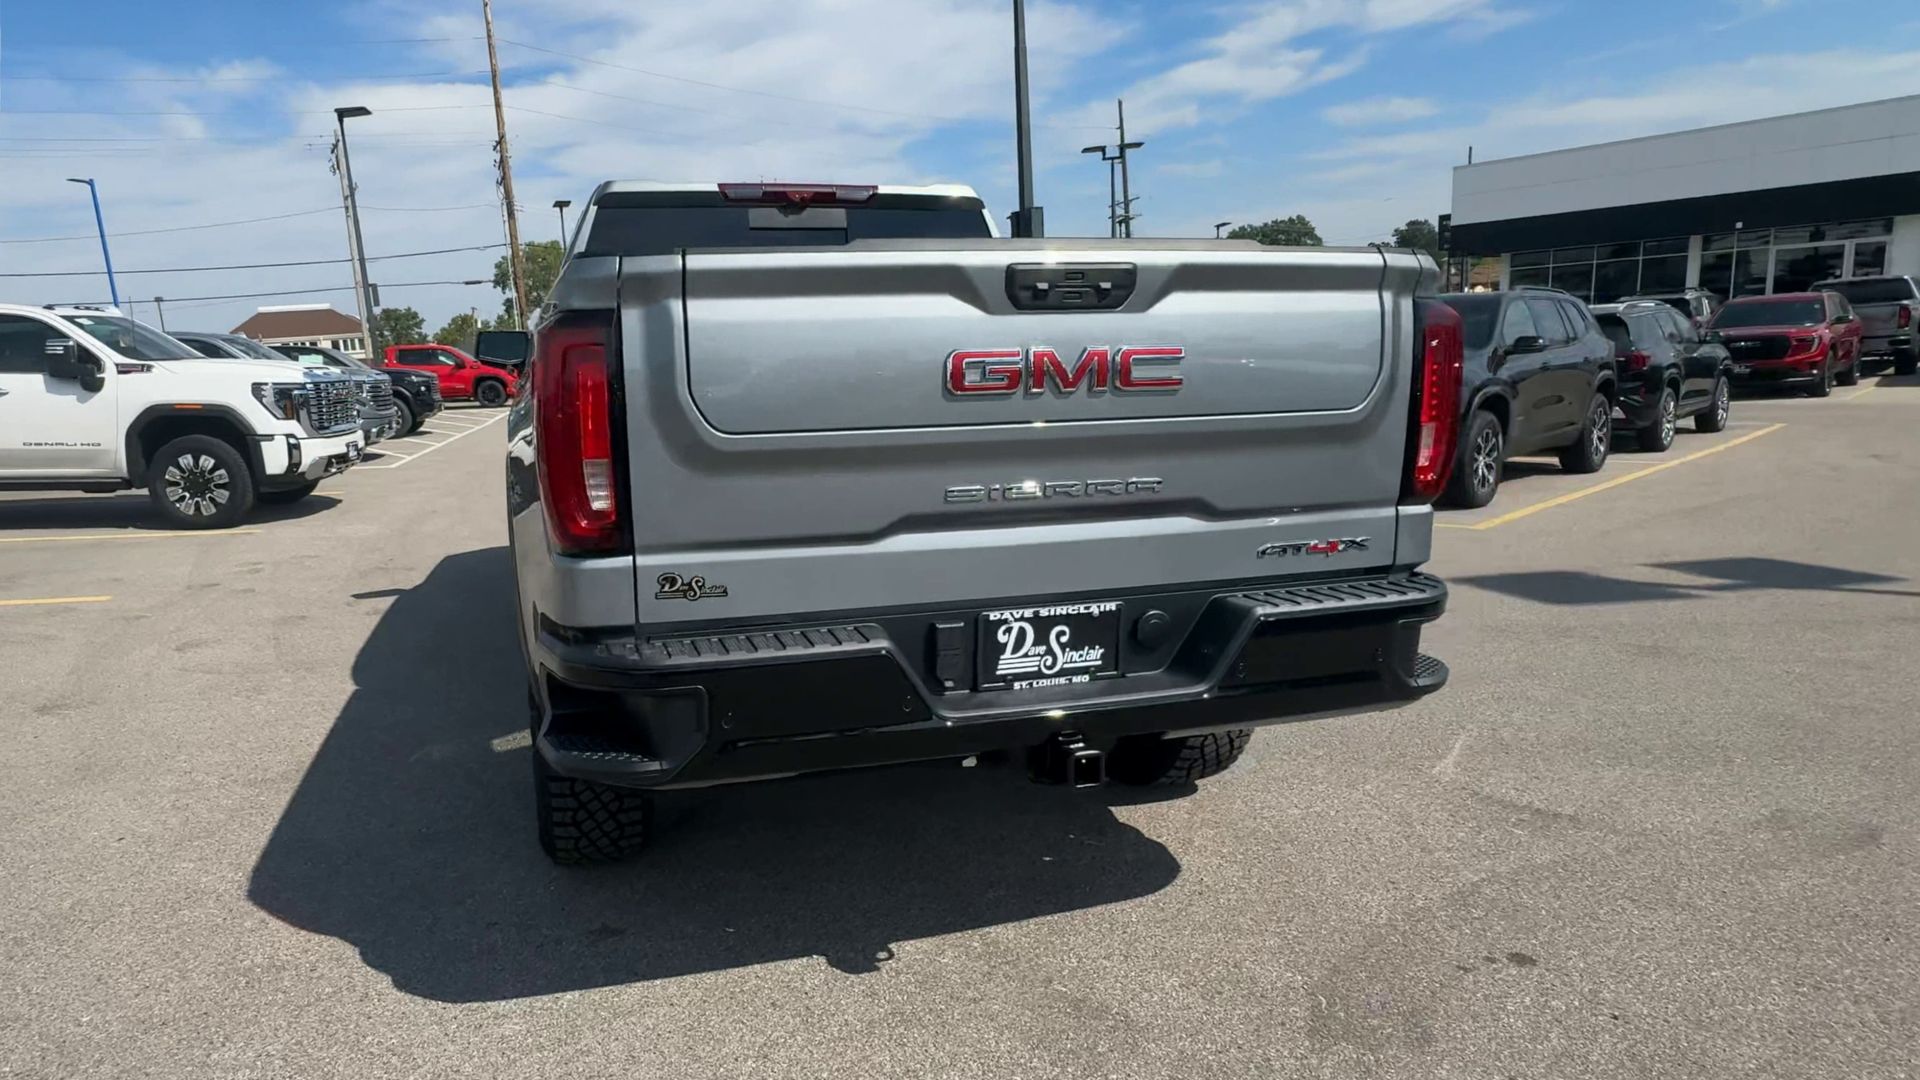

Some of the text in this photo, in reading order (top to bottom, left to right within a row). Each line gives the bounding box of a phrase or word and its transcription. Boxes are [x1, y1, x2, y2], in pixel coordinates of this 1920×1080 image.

[946, 346, 1185, 396] GMC
[944, 477, 1163, 502] SIERRA
[1257, 536, 1371, 559] AT4X
[989, 603, 1117, 621] DAVE SINCLAIR
[997, 621, 1104, 674] Dave Sinclair
[1071, 674, 1090, 684] MO
